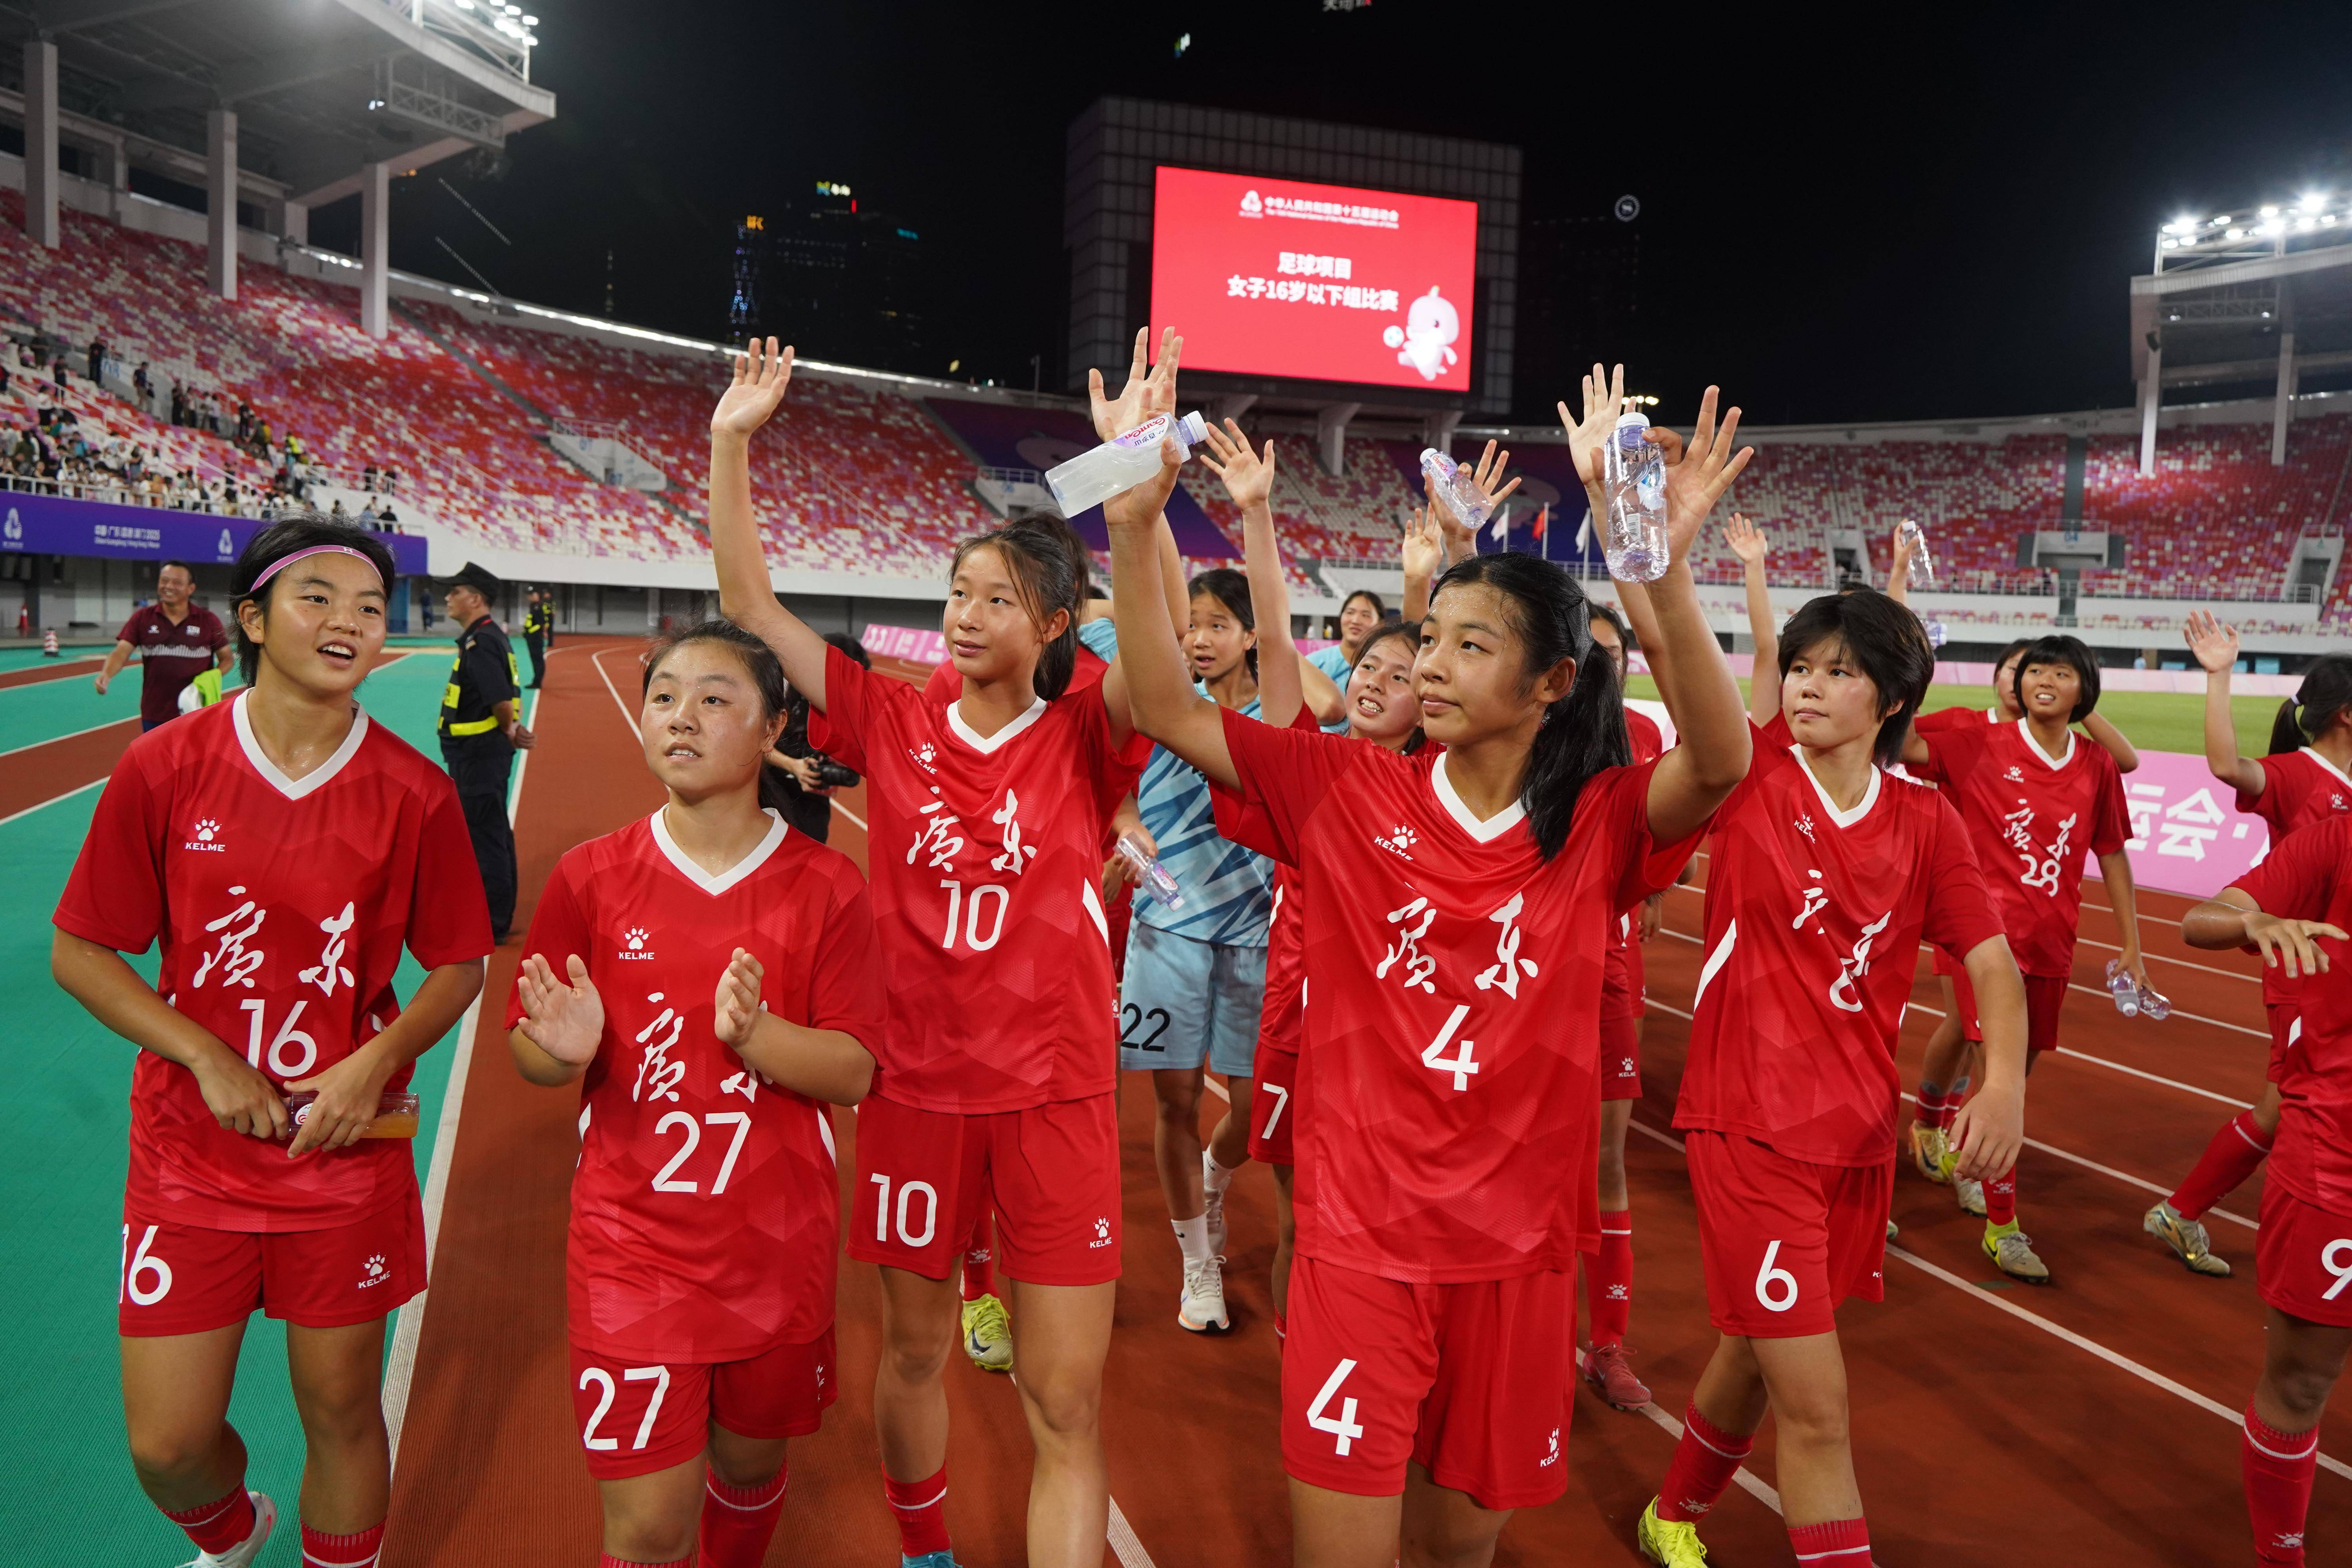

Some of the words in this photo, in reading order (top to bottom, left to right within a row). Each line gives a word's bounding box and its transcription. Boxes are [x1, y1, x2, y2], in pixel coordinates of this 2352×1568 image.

[1277, 251, 1352, 280] 足球项目
[1227, 274, 1399, 312] 女子16岁以下组比赛
[1134, 432, 1156, 446] 百岁山
[908, 748, 937, 775] KELME
[2003, 774, 2025, 783] KELME
[185, 842, 226, 852] KELME
[1374, 835, 1414, 861] KELME
[940, 879, 1009, 951] 10
[619, 951, 655, 960] KELME
[240, 999, 318, 1077] 16
[1120, 1002, 1171, 1052] 22
[1421, 1004, 1479, 1091] 4
[1261, 1082, 1289, 1140] 7
[651, 1111, 752, 1195] 27
[870, 1173, 938, 1247] 10
[1089, 1237, 1112, 1249] KELME
[358, 1270, 391, 1289] KELME
[1755, 1240, 1798, 1312] 6
[2321, 1239, 2352, 1301] 9
[579, 1365, 671, 1450] 27
[1306, 1358, 1363, 1457] 4
